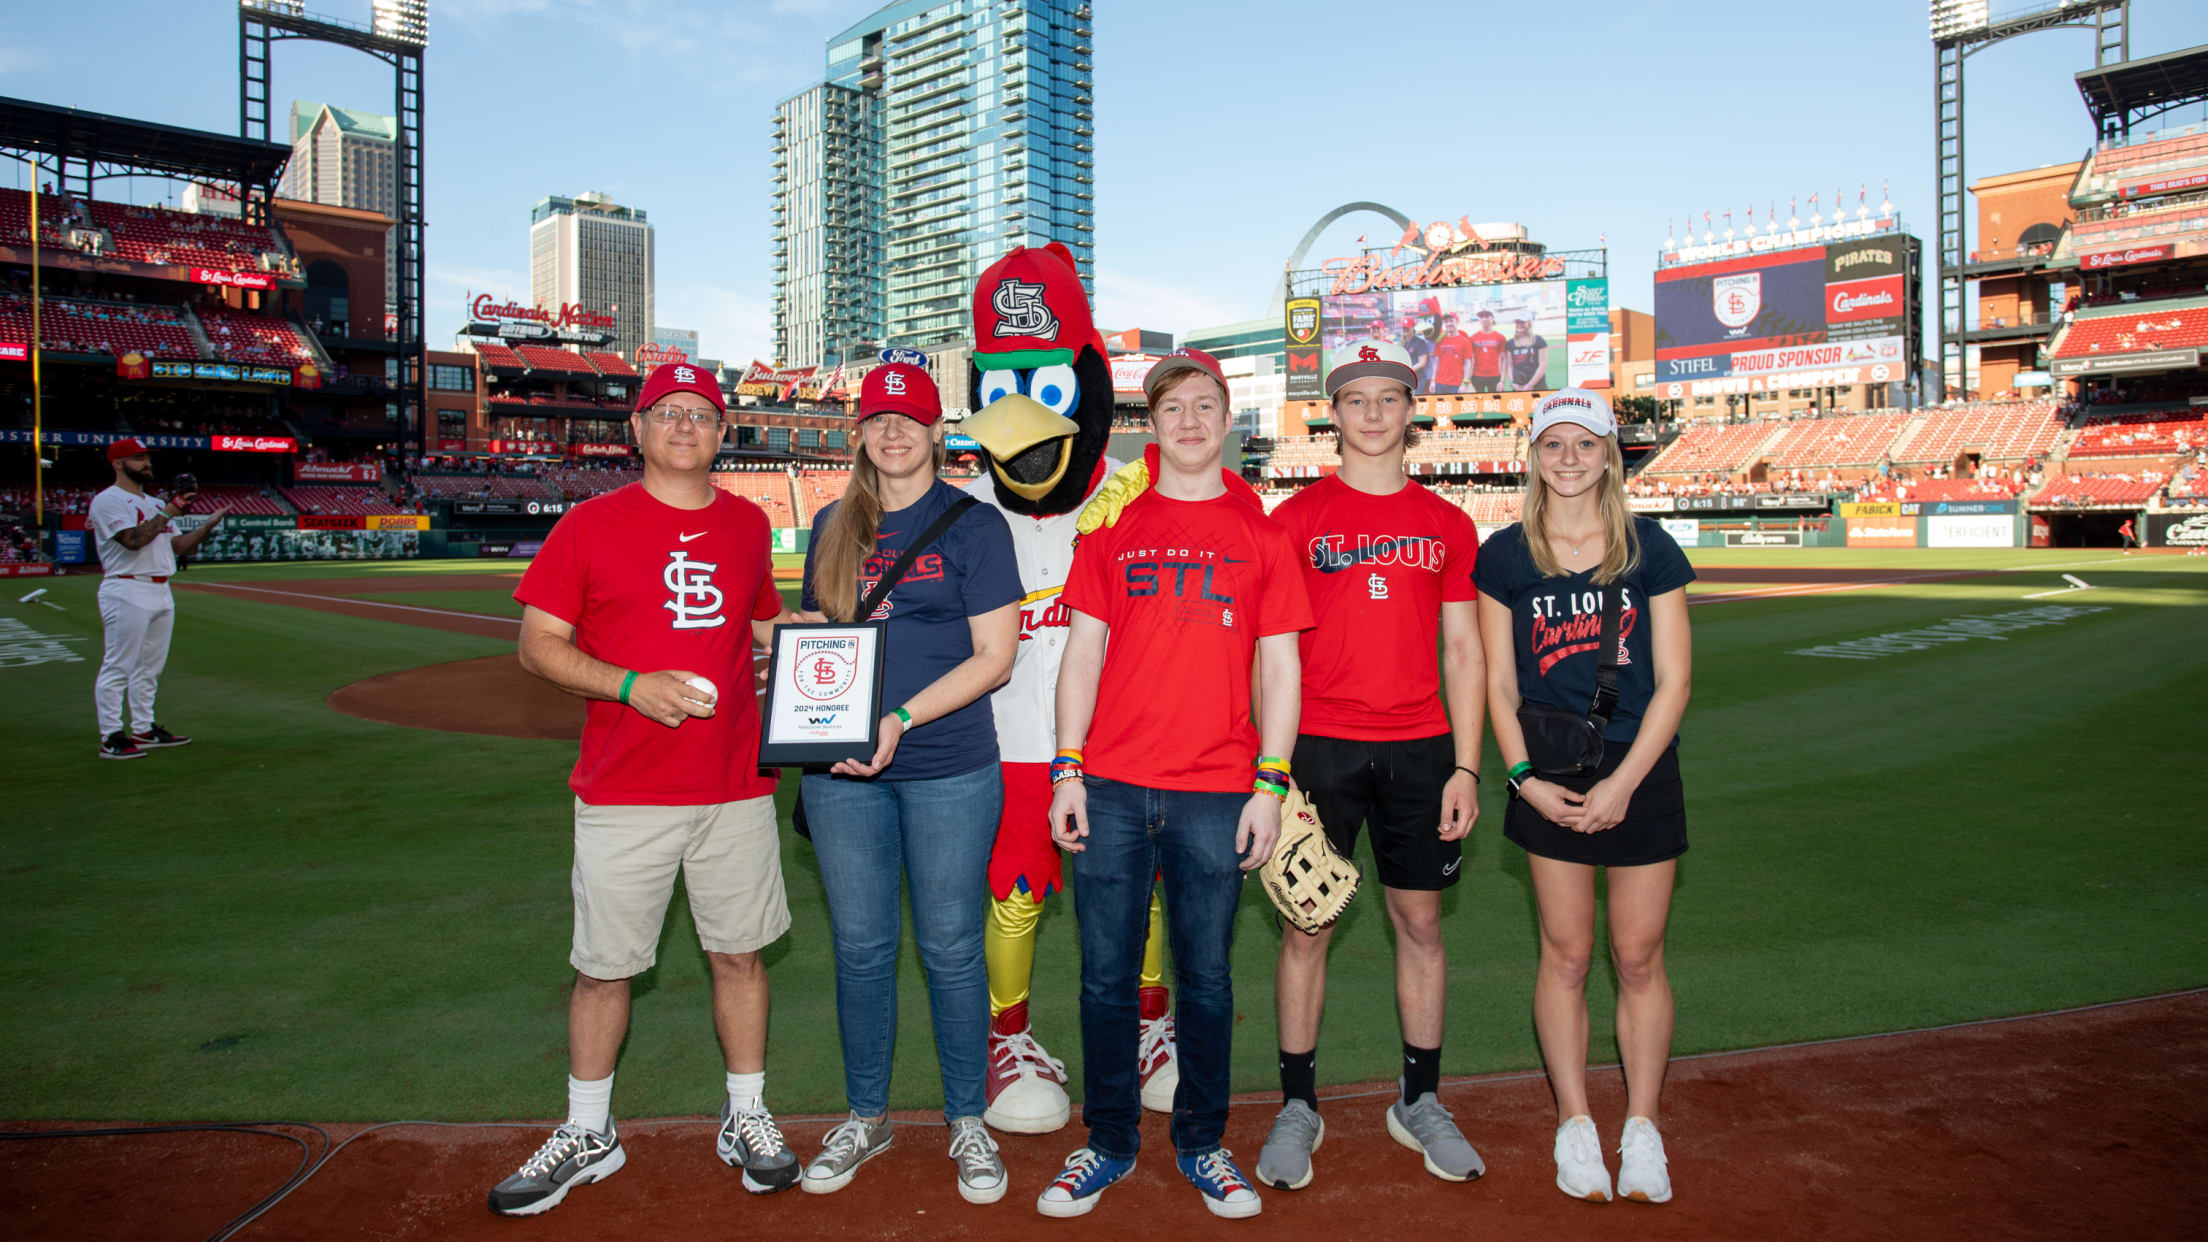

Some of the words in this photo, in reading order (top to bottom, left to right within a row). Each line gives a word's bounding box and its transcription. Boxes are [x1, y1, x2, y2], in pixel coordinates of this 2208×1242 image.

[1750, 219, 1876, 252] CHAMPIONS
[1835, 249, 1893, 272] PIRATES
[2124, 248, 2163, 262] Cardinals
[1322, 249, 1566, 295] Budweiser
[233, 273, 268, 287] Cardinals
[1834, 290, 1893, 312] Cardinals
[473, 293, 551, 322] Cardinals
[551, 302, 614, 329] Nation
[889, 348, 921, 365] Ford
[1670, 356, 1718, 375] STIFEL
[1732, 356, 1775, 372] PROUD
[1778, 346, 1842, 369] SPONSOR
[152, 361, 192, 378] BIG
[193, 363, 240, 380] MAC
[242, 366, 291, 385] LAND
[737, 383, 776, 396] BREW
[1691, 377, 1748, 395] BROWN
[254, 438, 289, 450] Cardinals
[298, 463, 354, 474] Schnucks
[1432, 462, 1479, 475] THE
[543, 504, 563, 513] 6:15
[1693, 499, 1713, 508] 6:15
[1856, 505, 1893, 515] FABICK
[1901, 503, 1920, 515] CAT
[240, 517, 270, 528] Central
[272, 518, 296, 528] Bank
[303, 516, 359, 529] SEATGEEK
[379, 517, 418, 526] DOBBS
[1944, 525, 2007, 538] ERFICIENT
[1118, 549, 1157, 561] JUST
[1167, 548, 1189, 557] DO
[1199, 551, 1215, 559] IT
[1309, 534, 1353, 569] ST.
[1358, 534, 1446, 573] LOUIS
[1125, 562, 1234, 605] STL
[1532, 595, 1562, 619] ST.
[800, 640, 846, 649] PITCHING
[819, 669, 851, 697] COMMUNITY
[794, 704, 814, 713] 2024
[816, 704, 850, 712] HONOREE
